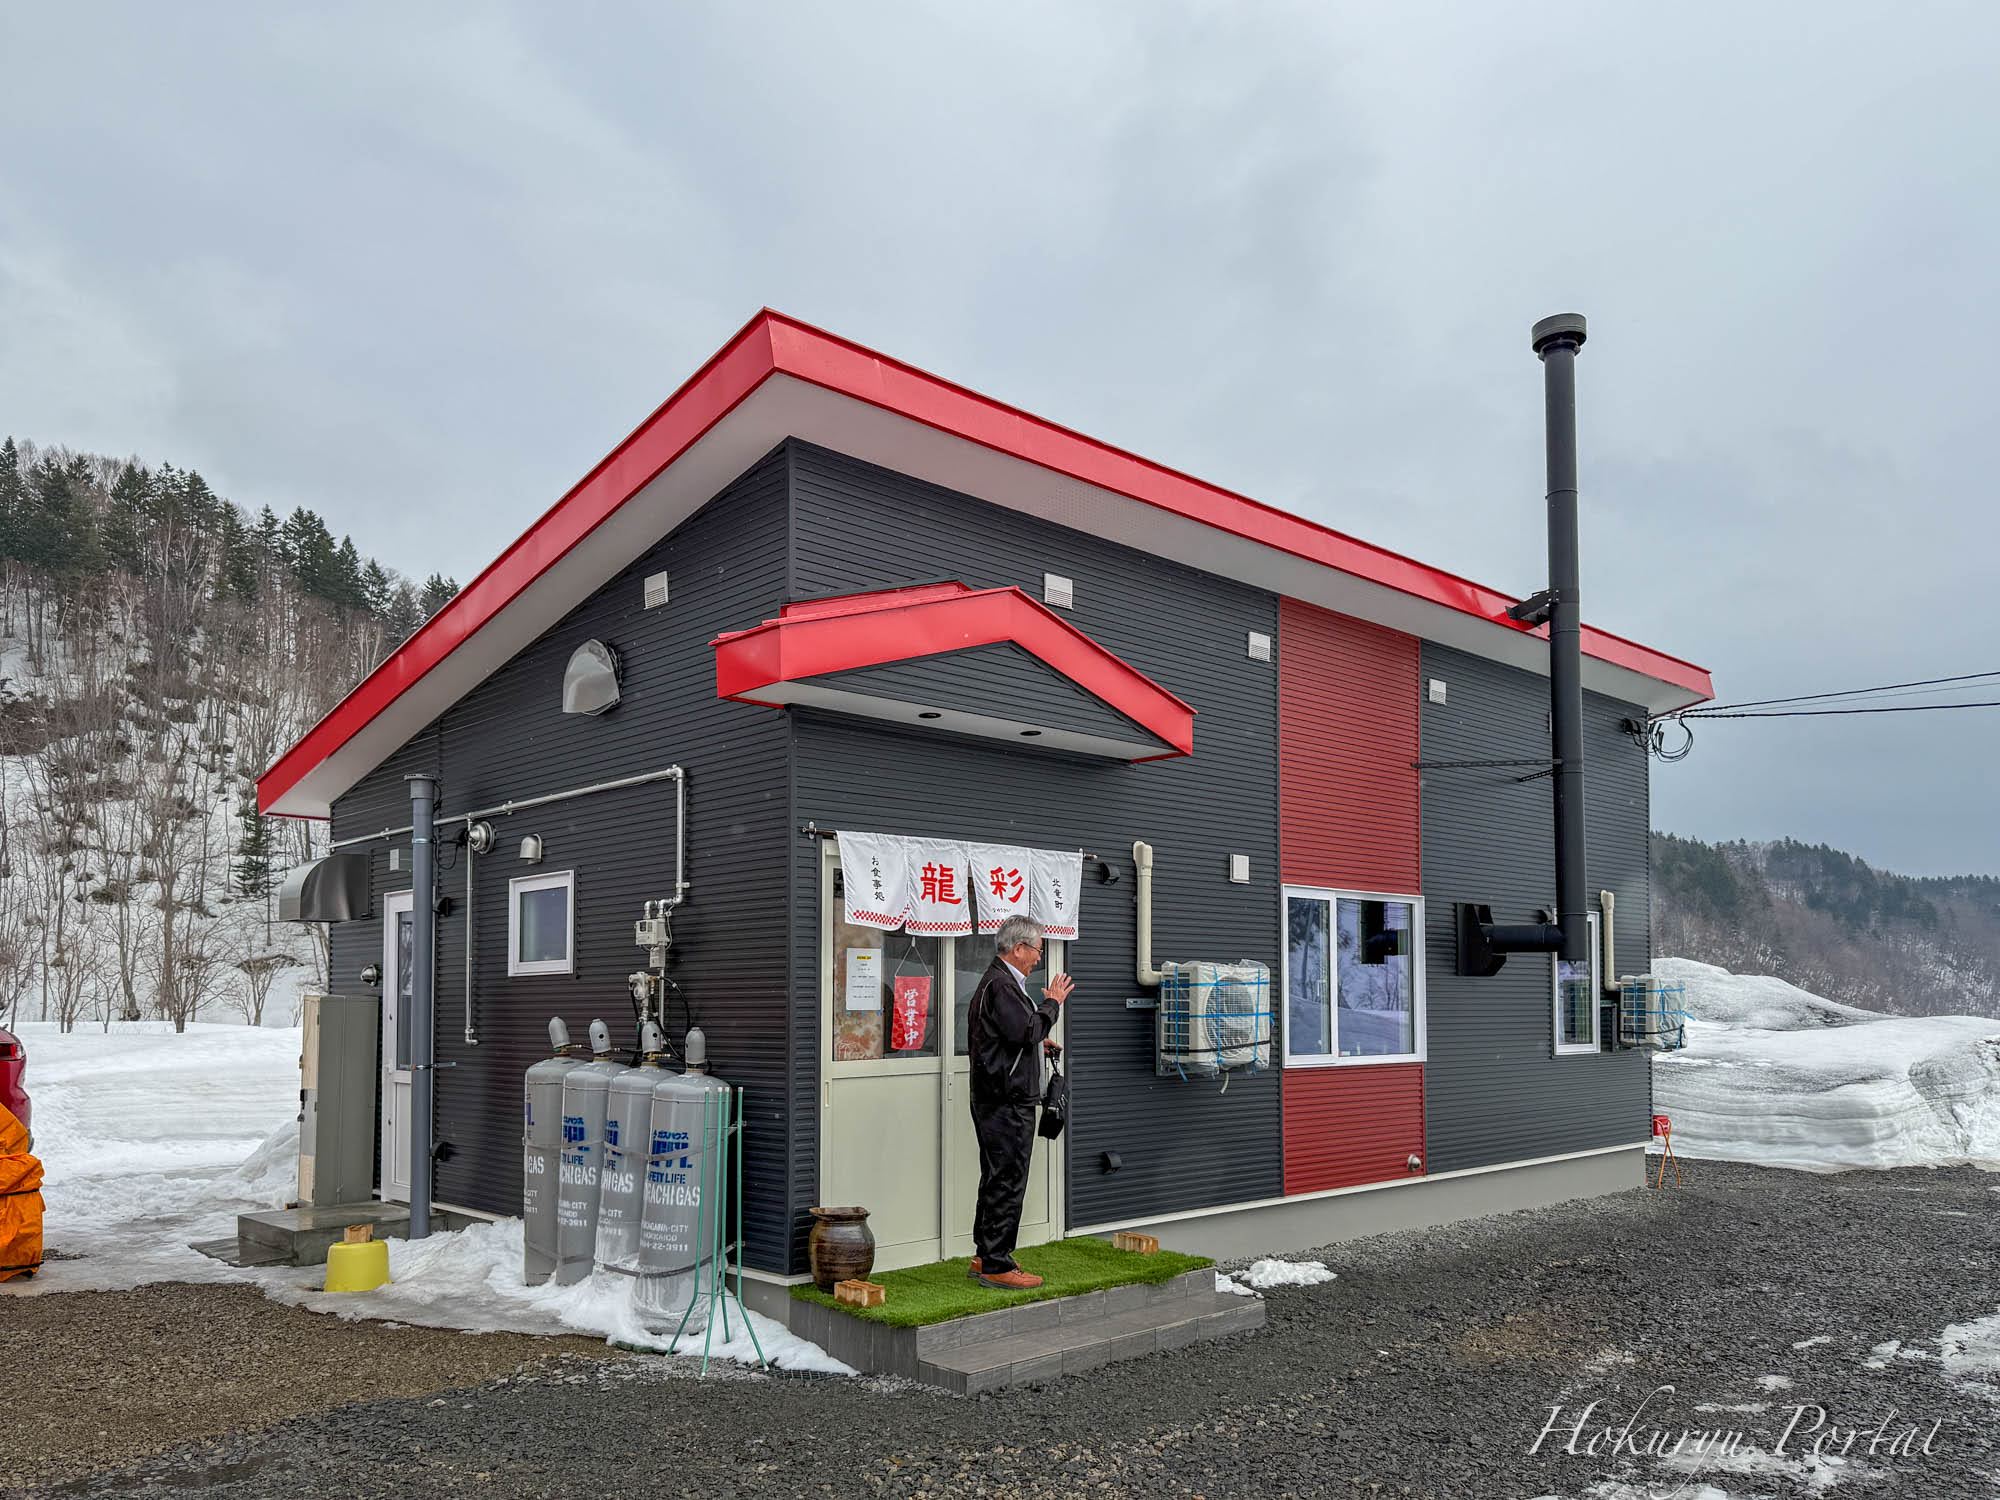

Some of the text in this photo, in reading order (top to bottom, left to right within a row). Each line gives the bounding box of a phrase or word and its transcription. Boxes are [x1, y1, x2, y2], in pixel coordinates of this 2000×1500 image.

[870, 855, 885, 902] お食事処
[903, 987, 920, 1047] 営業中
[528, 1155, 544, 1175] GAS
[575, 1166, 597, 1186] GAS
[612, 1172, 634, 1194] GAS
[665, 1172, 686, 1185] LIFE
[676, 1185, 701, 1207] GAS
